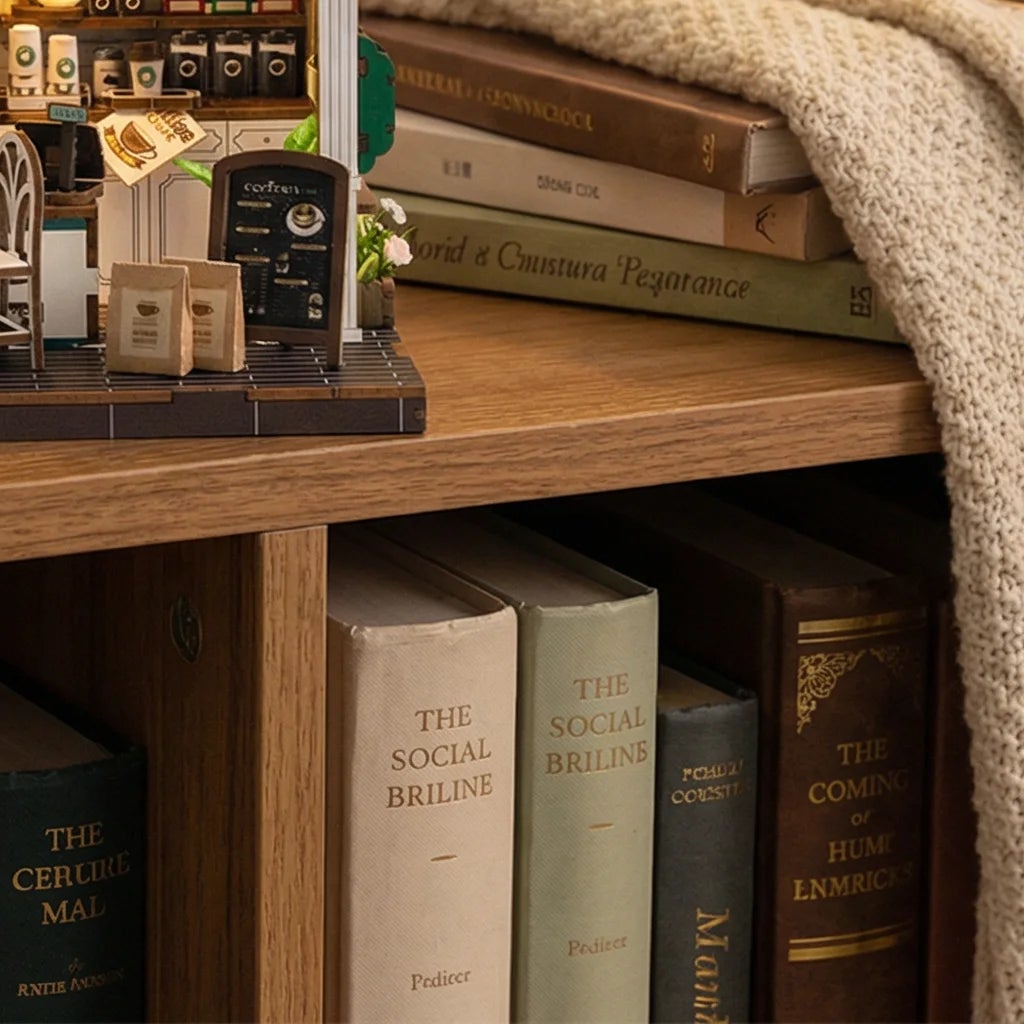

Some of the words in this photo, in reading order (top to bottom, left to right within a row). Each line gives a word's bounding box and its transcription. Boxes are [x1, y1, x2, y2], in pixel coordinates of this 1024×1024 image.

[573, 673, 629, 700] THE
[415, 704, 473, 732] THE
[549, 706, 647, 739] SOCIAL
[391, 737, 492, 771] SOCIAL
[837, 738, 889, 765] THE
[385, 773, 493, 809] BRILINE
[45, 822, 104, 852] THE
